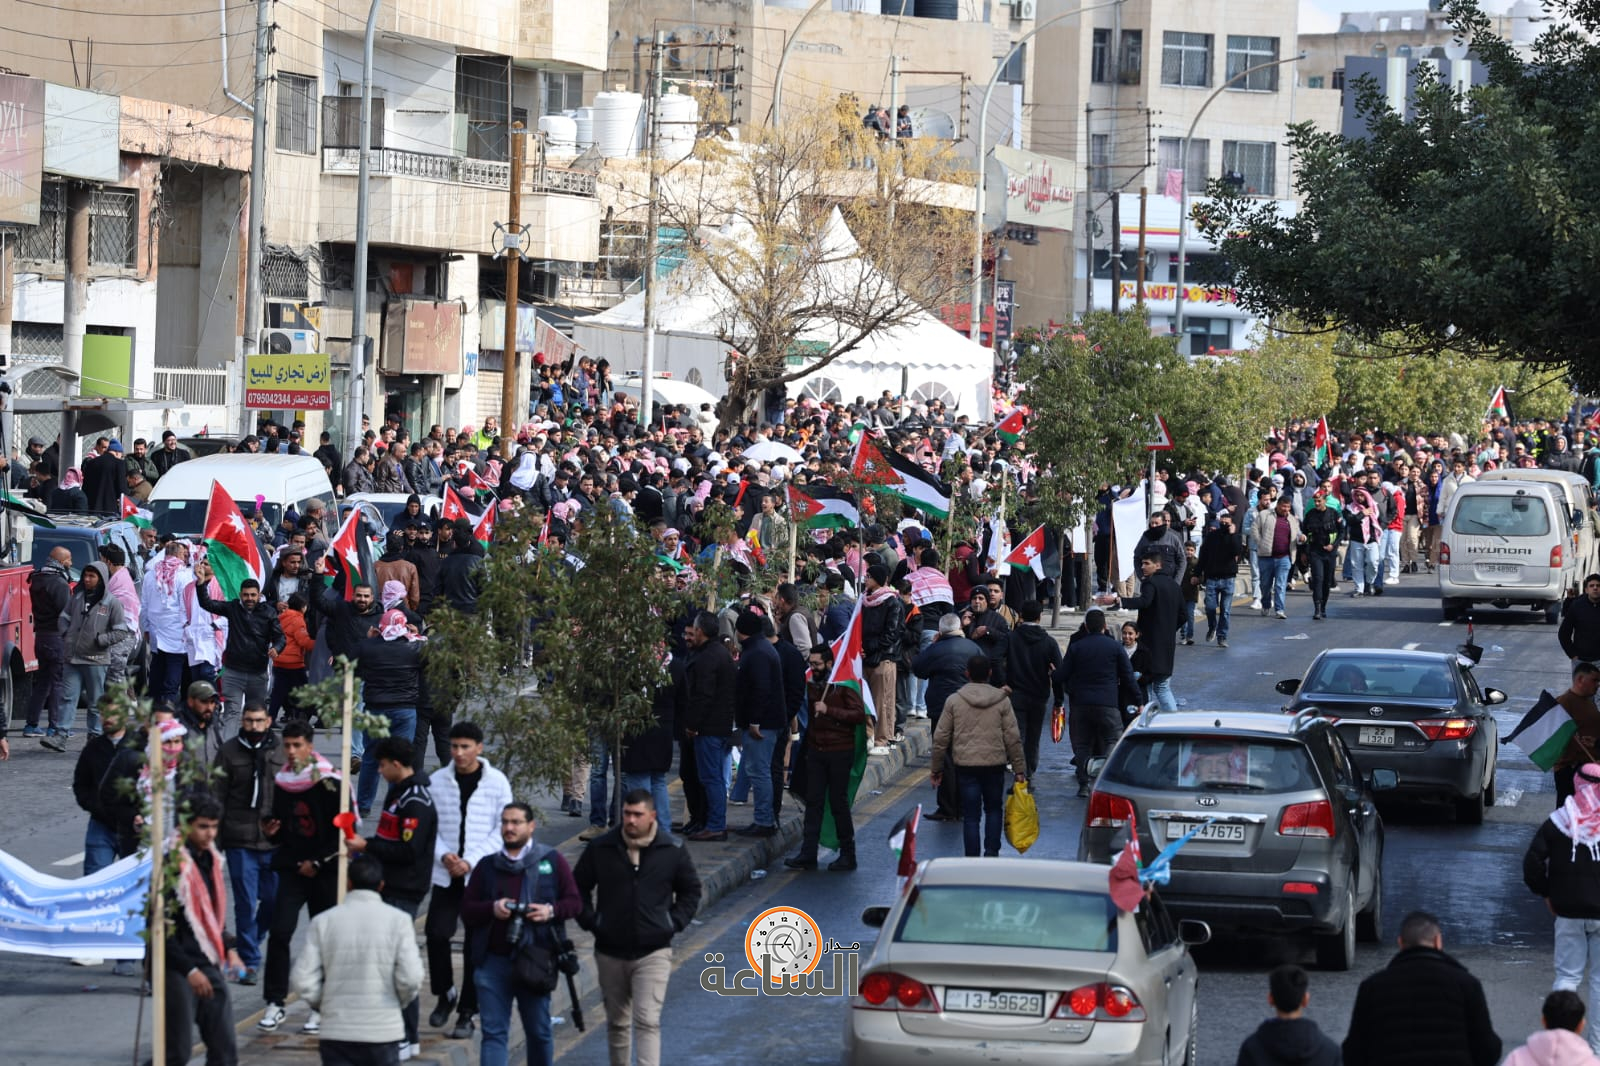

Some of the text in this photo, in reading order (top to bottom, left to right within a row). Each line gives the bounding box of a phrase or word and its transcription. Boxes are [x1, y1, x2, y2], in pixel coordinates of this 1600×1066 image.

[998, 286, 1010, 298] PE
[997, 301, 1009, 312] OP
[250, 362, 327, 384] أرض تجاري للبيع
[247, 392, 291, 405] 0795042344
[1467, 547, 1532, 555] HYUNDAI
[1374, 728, 1386, 736] 22
[1367, 735, 1393, 744] 13210
[964, 993, 1039, 1012] 13-59629
